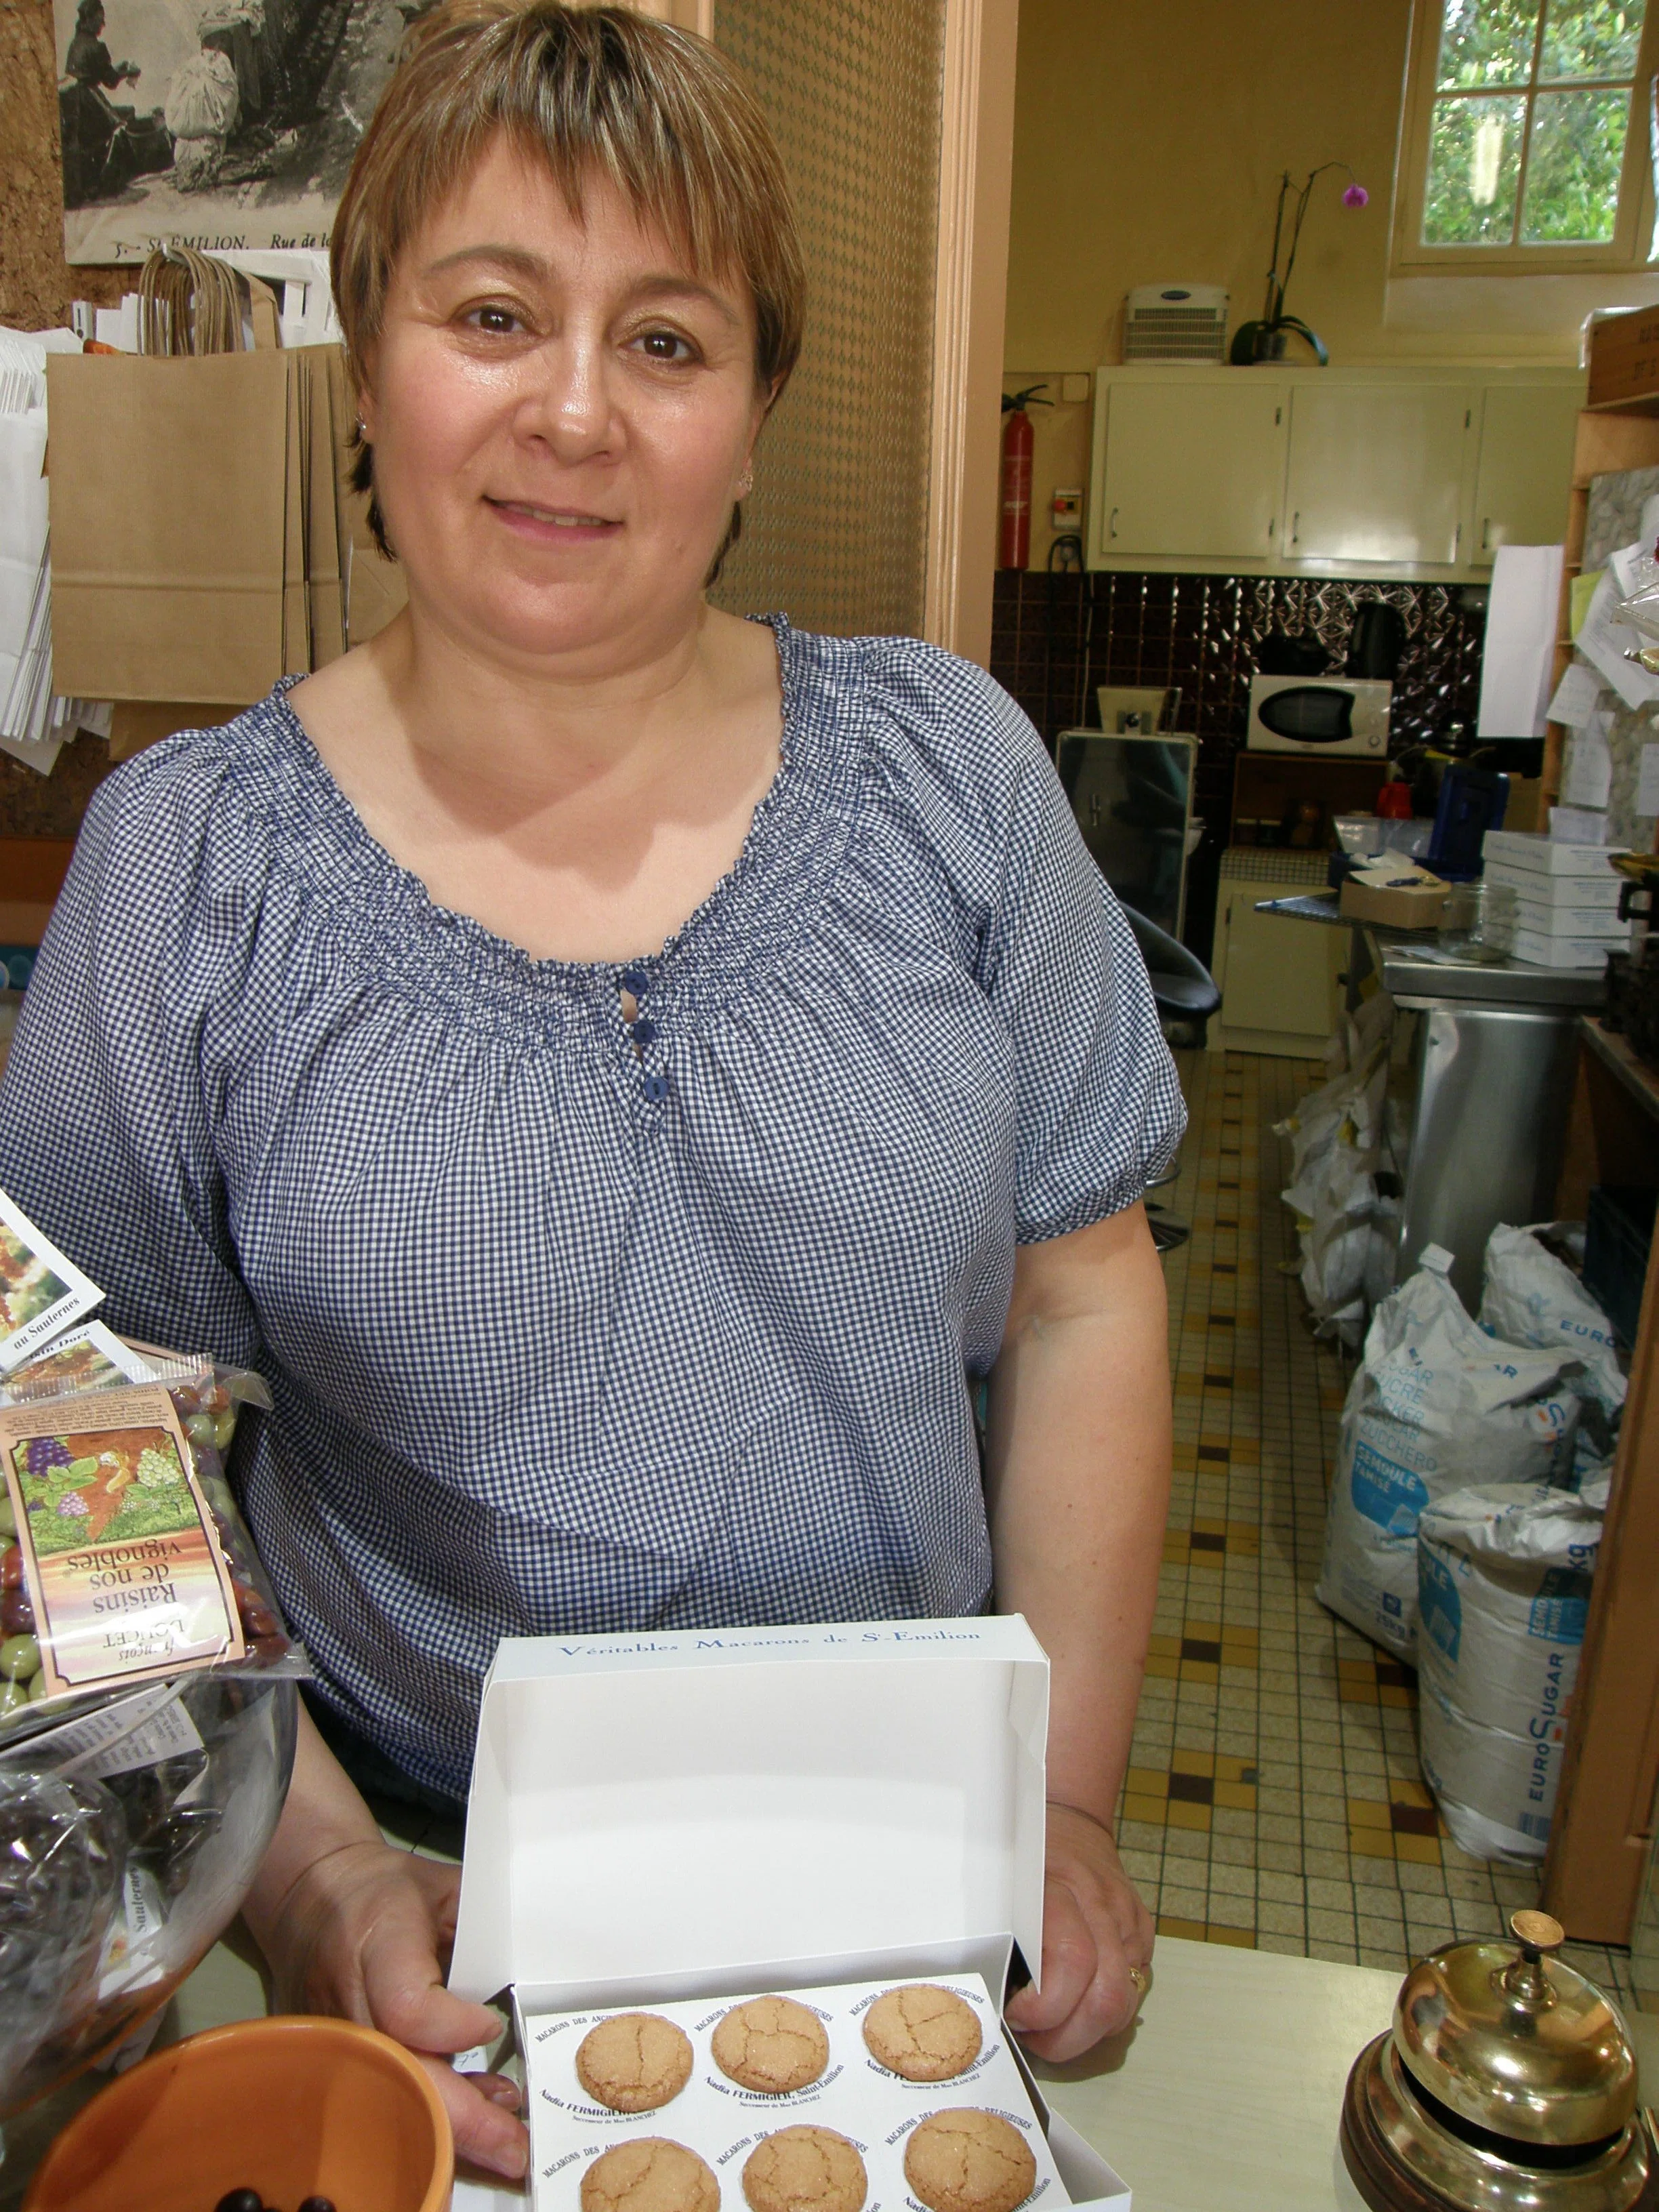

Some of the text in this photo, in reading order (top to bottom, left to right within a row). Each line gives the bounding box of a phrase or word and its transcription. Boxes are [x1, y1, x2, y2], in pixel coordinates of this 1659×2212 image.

[271, 234, 295, 249] Rue
[301, 232, 314, 248] de
[14, 1297, 80, 1350] au Sauternes
[68, 1539, 182, 1572] vignobles
[89, 1563, 169, 1591] de nos
[93, 1582, 177, 1614] Raisins
[559, 1642, 678, 1656] Véritables
[693, 1638, 809, 1649] Macarons
[823, 1634, 847, 1643] de
[535, 2022, 570, 2043] MACARONS
[573, 2016, 588, 2026] DES
[694, 2008, 726, 2032] MACARONS
[864, 2058, 891, 2078] Nadia
[539, 2089, 565, 2108] Nadia
[703, 2076, 730, 2095] Nadia
[884, 2117, 918, 2146] MACARONS
[542, 2151, 581, 2178] MACARONS
[583, 2146, 600, 2157] DES
[716, 2136, 752, 2166] MACARONS
